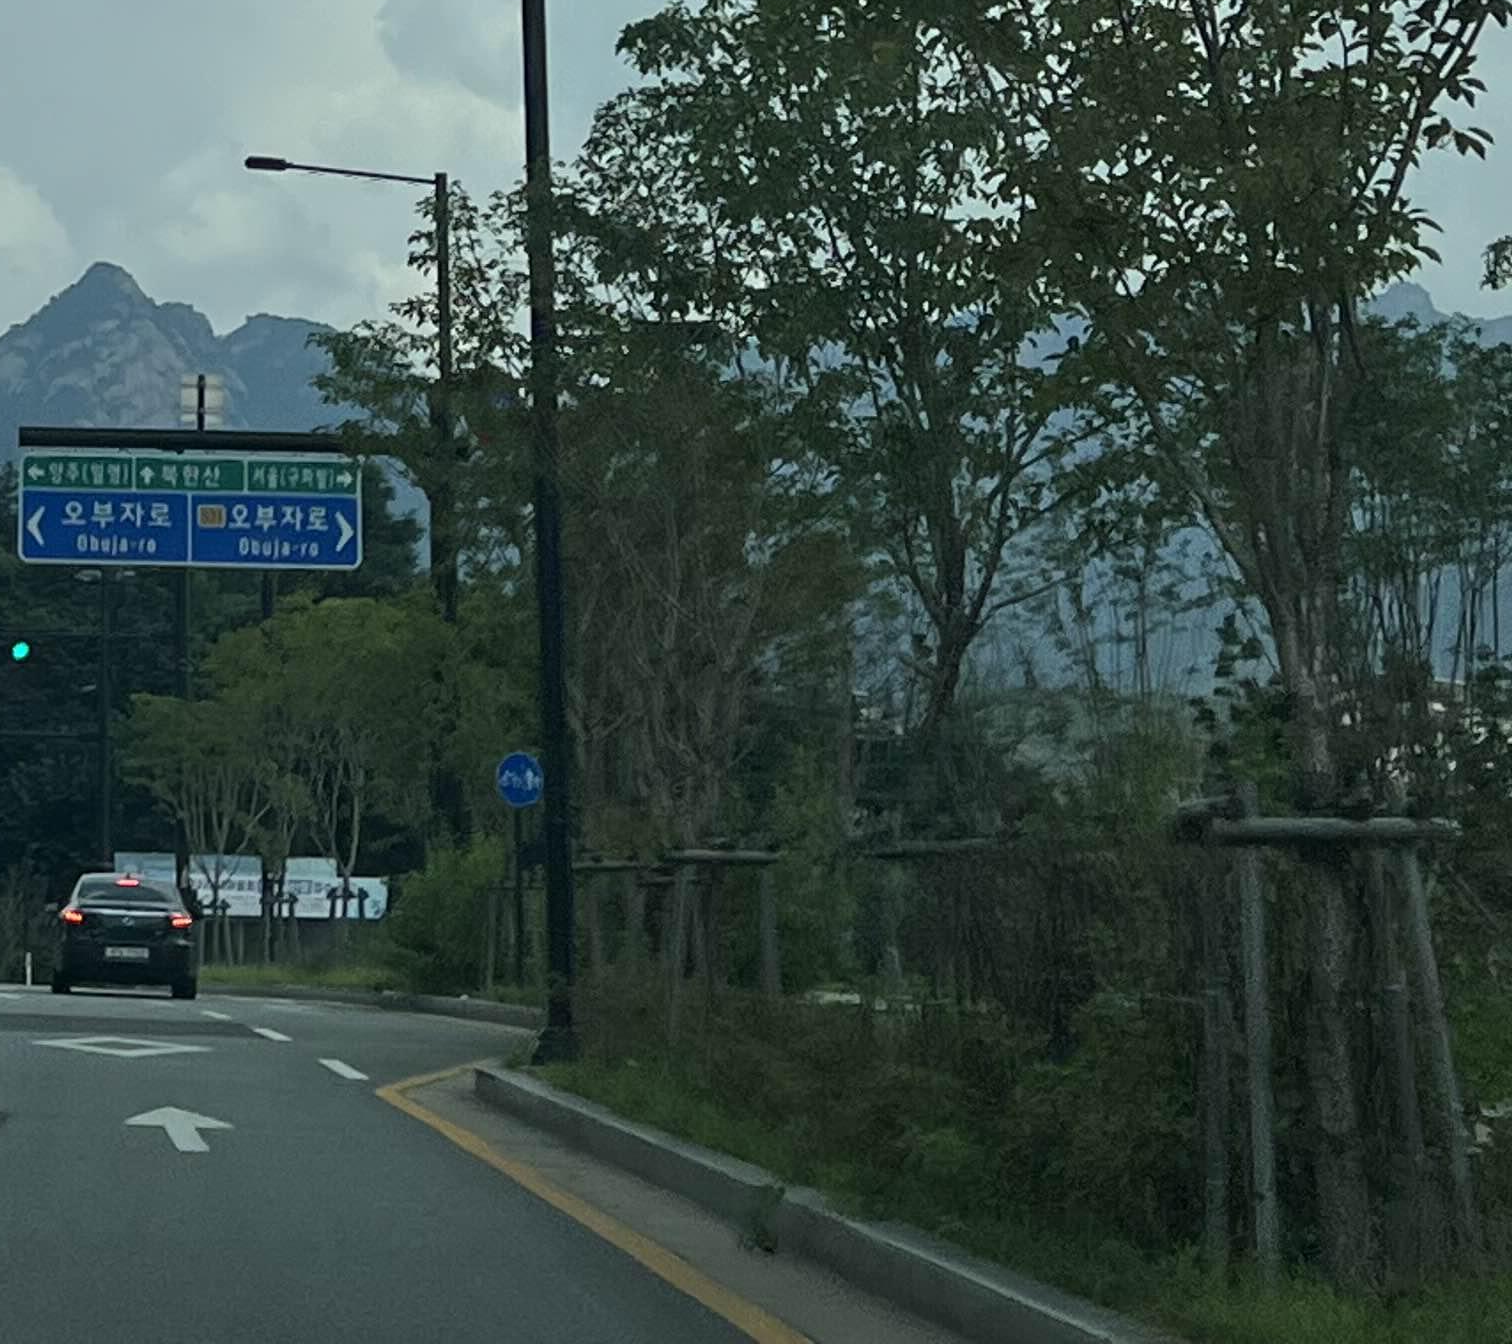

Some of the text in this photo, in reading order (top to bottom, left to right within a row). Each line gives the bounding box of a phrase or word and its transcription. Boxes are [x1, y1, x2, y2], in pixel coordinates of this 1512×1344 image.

[161, 464, 221, 488] 북한산
[61, 500, 172, 529] 오부자로
[228, 503, 329, 532] 오부자로
[76, 535, 157, 557] Obuja-ro
[239, 536, 319, 560] Obuja-ro
